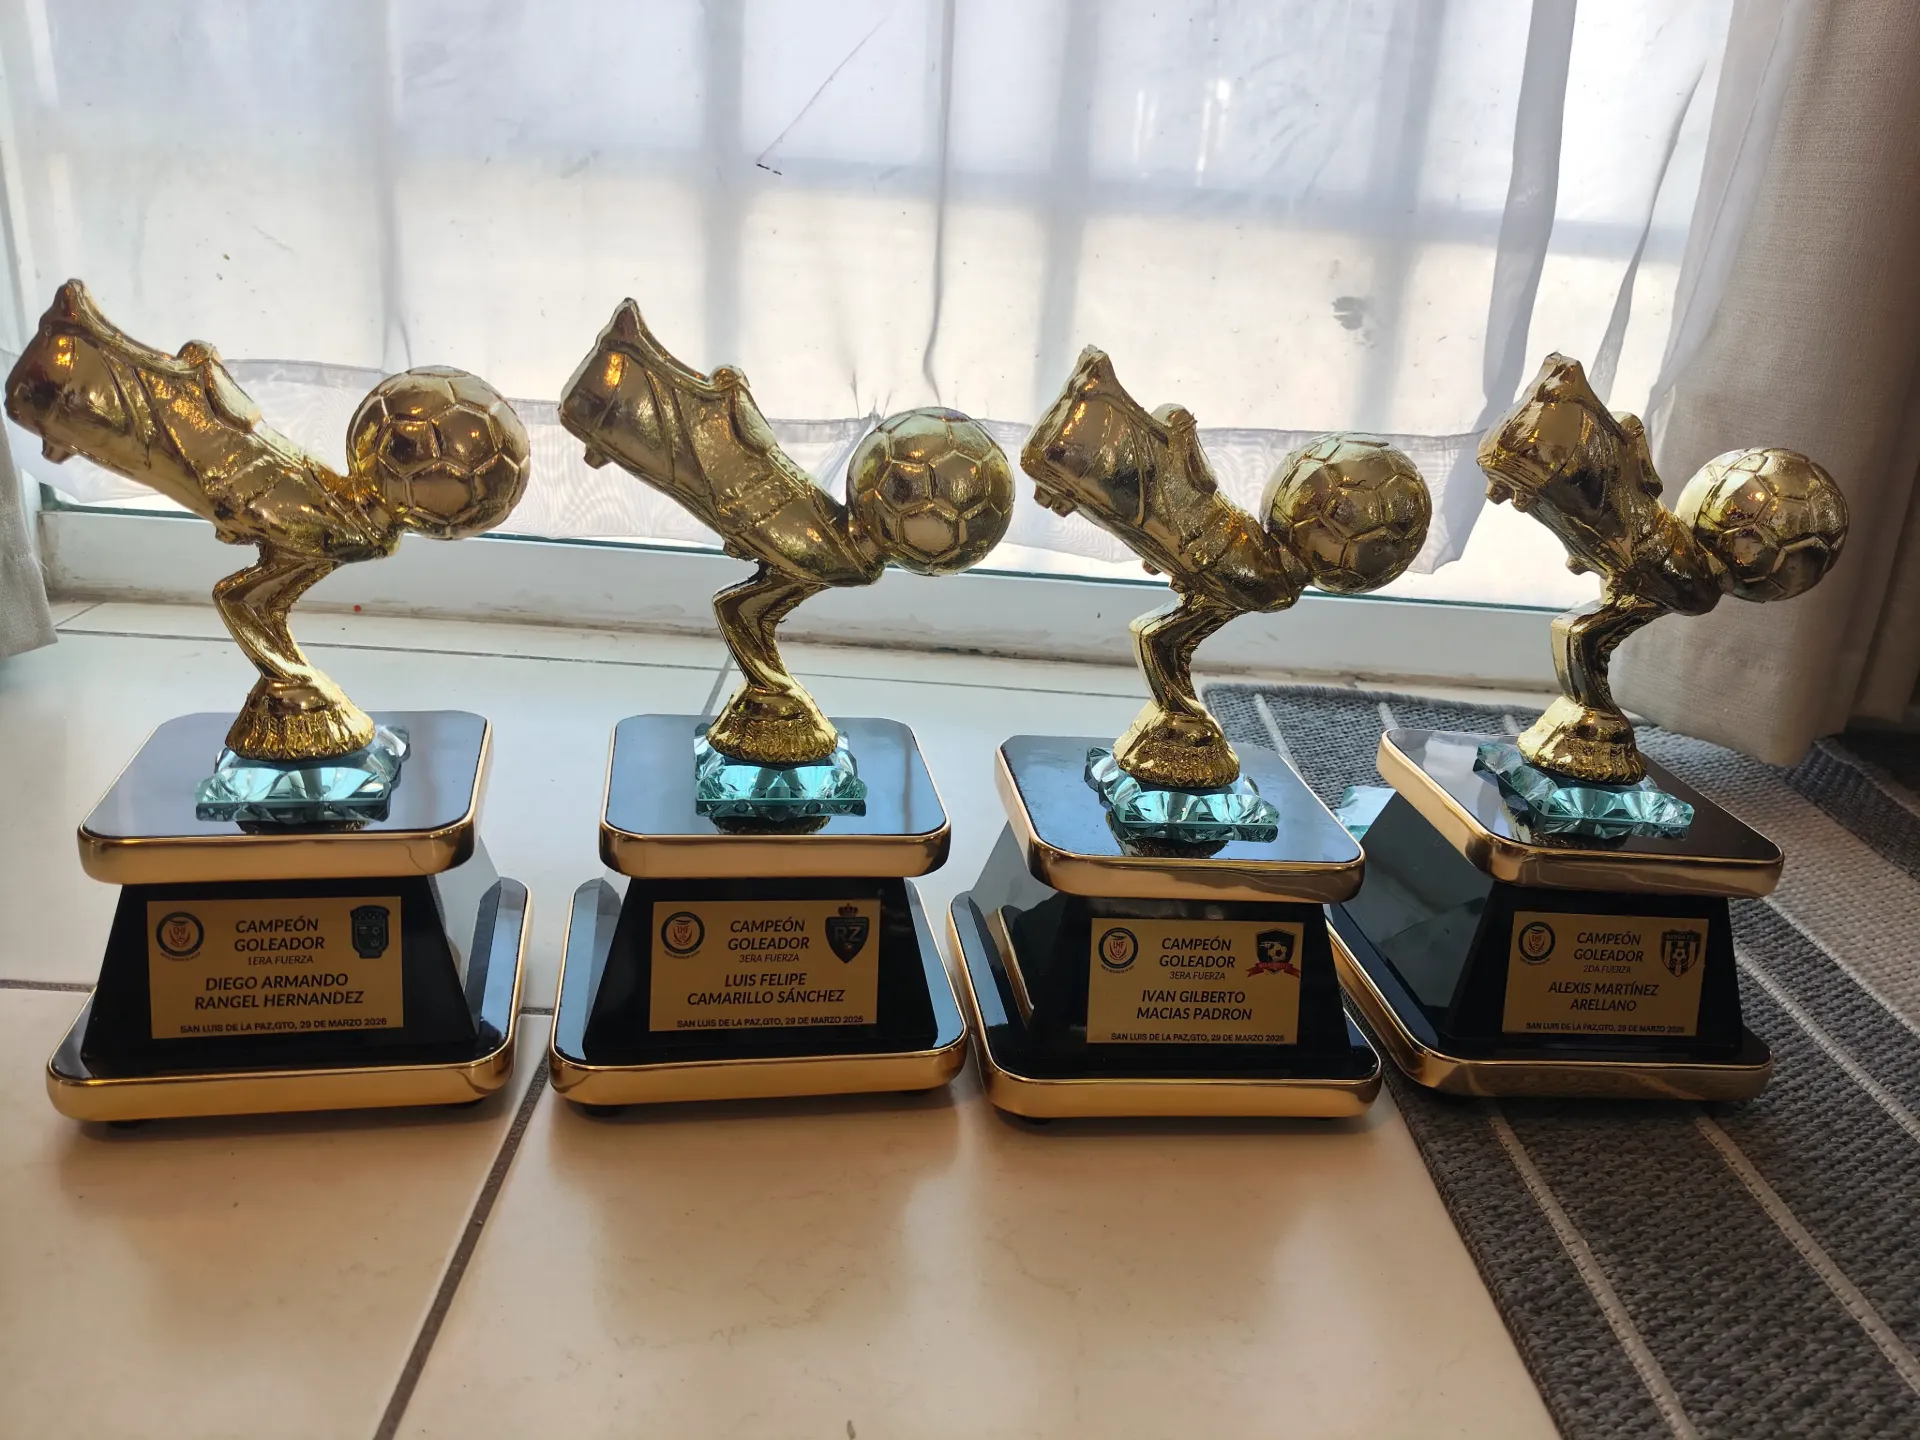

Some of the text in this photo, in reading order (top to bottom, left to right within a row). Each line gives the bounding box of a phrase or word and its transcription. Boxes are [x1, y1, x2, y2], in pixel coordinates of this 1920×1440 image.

[236, 916, 319, 933] CAMPEÓN
[730, 917, 805, 933] CAMPEÓN
[834, 927, 862, 942] RZ
[1577, 931, 1641, 945] CAMPEÓN
[234, 937, 325, 952] GOLEADOR
[728, 937, 809, 950] GOLEADOR
[1162, 936, 1231, 950] CAMPEÓN
[248, 955, 313, 965] 1ERA FUERZA
[765, 954, 799, 962] FUERZA
[1159, 955, 1235, 968] GOLEADOR
[1574, 949, 1643, 962] GOLEADOR
[1193, 972, 1225, 980] FUERZA
[1583, 965, 1600, 973] 2DA
[206, 974, 348, 991] DIEGO ARMANDO
[725, 973, 807, 987] LUIS FELIPE
[1548, 981, 1659, 996] ALEXIS MARTÍNEZ
[195, 991, 364, 1010] RANGEL HERNANDEZ
[687, 988, 845, 1005] CAMARILLO SÁNCHEZ
[1142, 990, 1245, 1003] IVAN GILBERTO
[1570, 999, 1636, 1011] ARELLANO
[1137, 1007, 1252, 1020] MACIAS PADRON
[180, 1025, 200, 1033] SAN
[203, 1024, 223, 1032] LUIS
[226, 1024, 238, 1032] DE
[241, 1023, 251, 1031] LA
[314, 1020, 326, 1028] DE
[329, 1019, 362, 1027] MARZO
